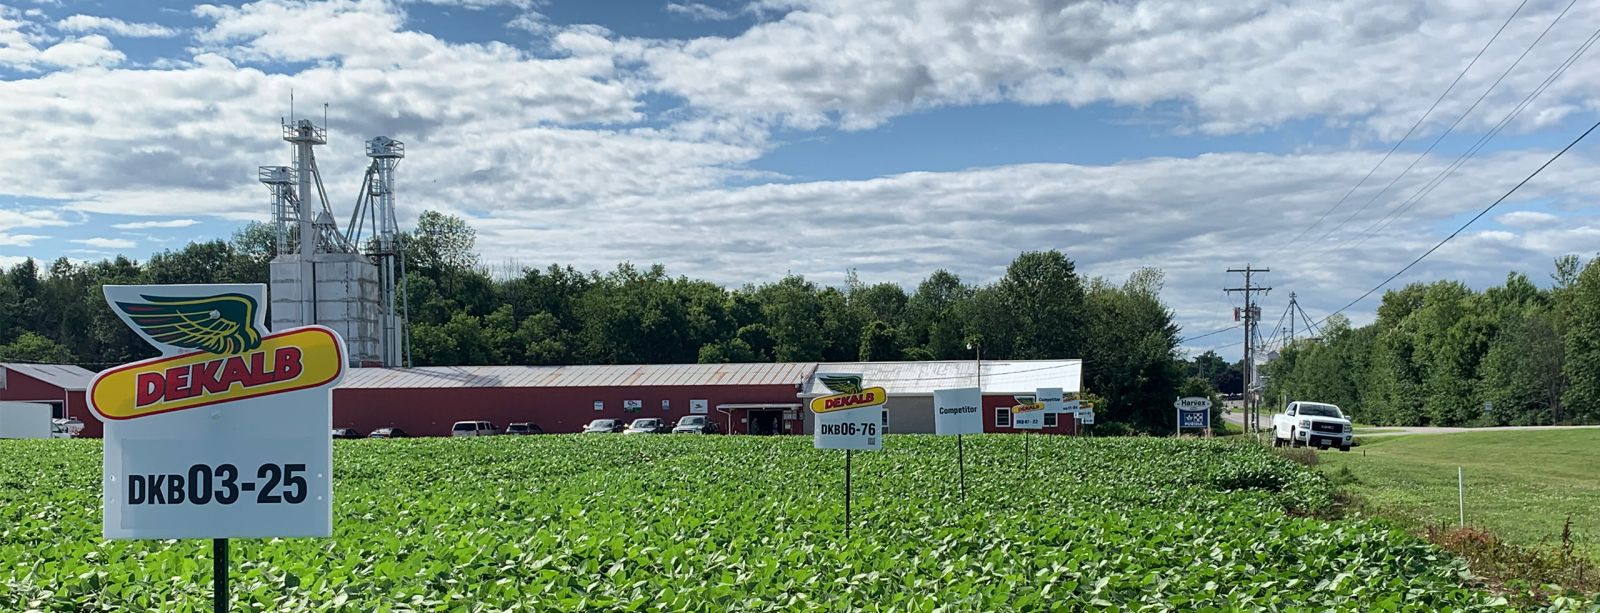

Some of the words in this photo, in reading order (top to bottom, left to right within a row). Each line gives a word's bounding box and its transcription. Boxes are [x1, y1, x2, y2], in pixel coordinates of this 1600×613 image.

[135, 347, 303, 408] DEKALB
[824, 392, 875, 410] DEKALB
[939, 405, 978, 415] Competitor
[821, 422, 876, 436] DKB06-76
[127, 463, 308, 505] DKB03-25
